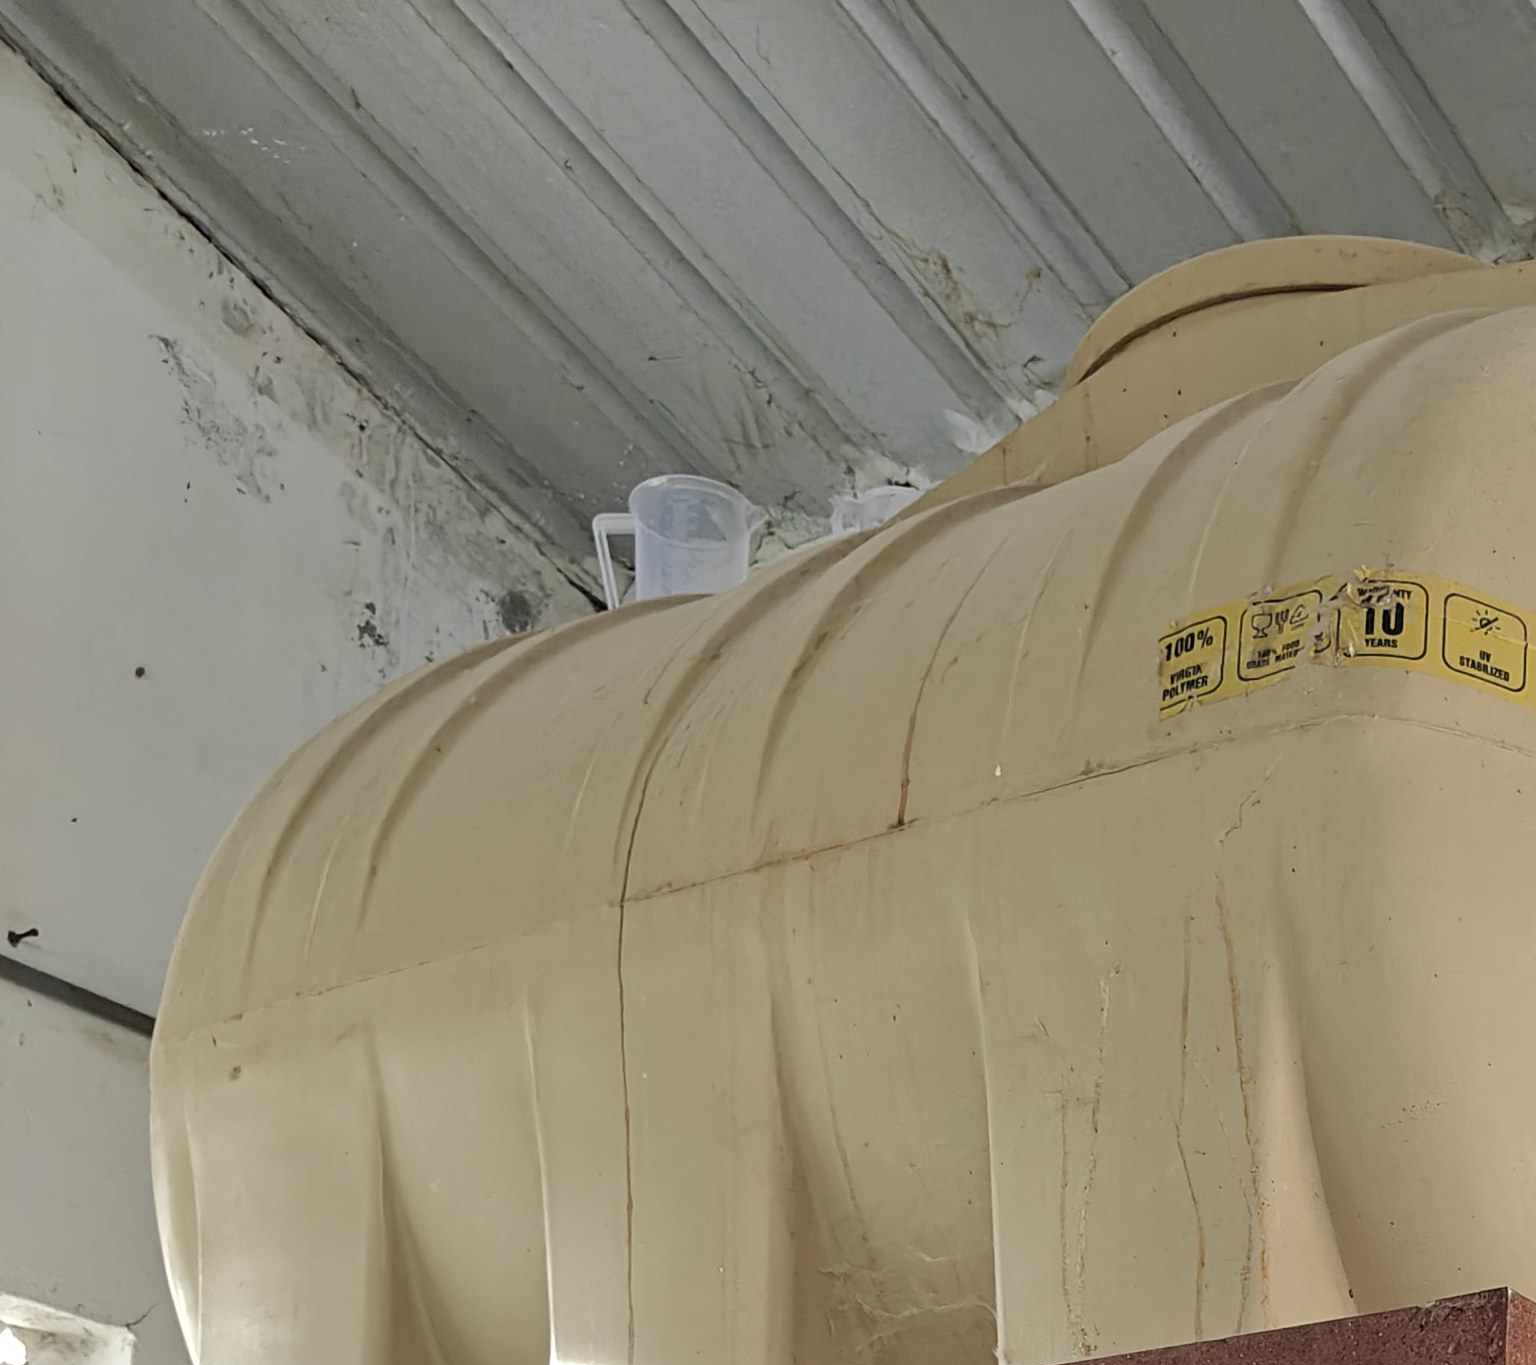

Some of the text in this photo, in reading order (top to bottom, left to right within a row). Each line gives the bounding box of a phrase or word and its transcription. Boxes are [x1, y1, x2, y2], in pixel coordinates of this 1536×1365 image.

[1165, 627, 1214, 662] 100%
[1364, 638, 1398, 649] YEARS
[1479, 650, 1491, 663] UV
[1459, 655, 1510, 682] STABILIZED
[1162, 674, 1208, 702] POLYMER
